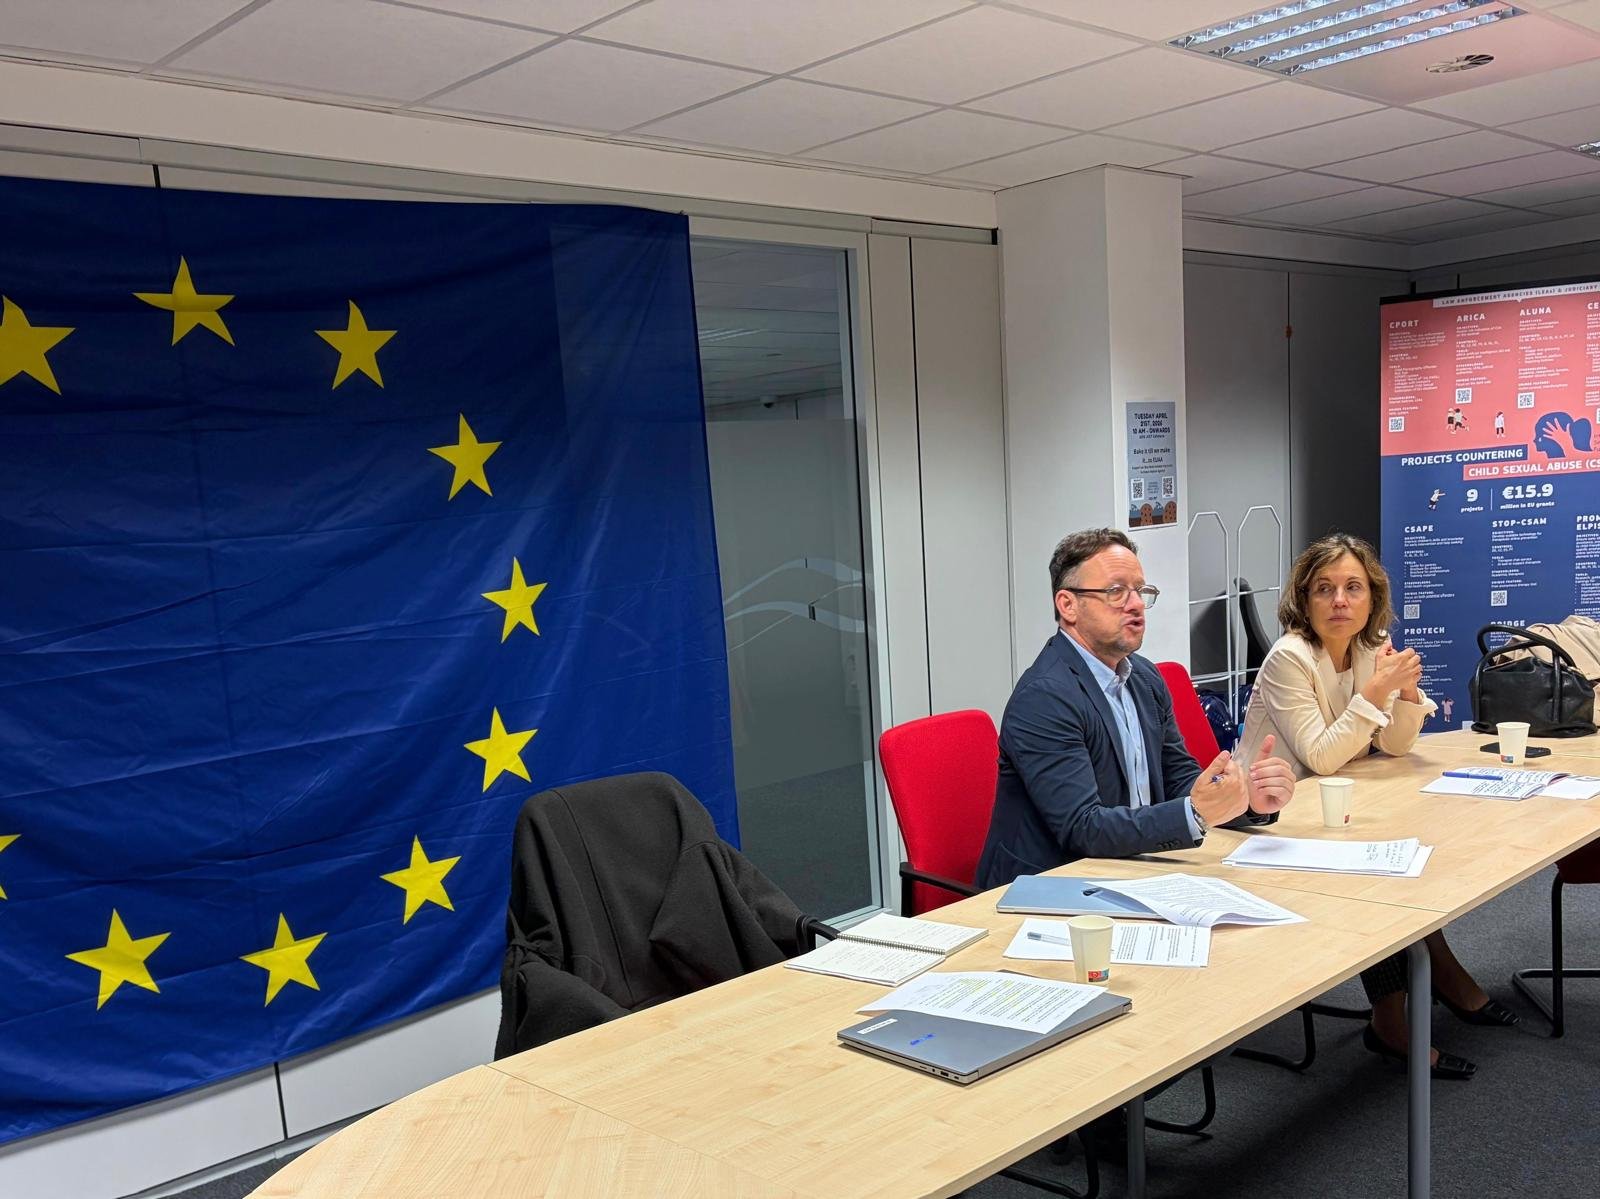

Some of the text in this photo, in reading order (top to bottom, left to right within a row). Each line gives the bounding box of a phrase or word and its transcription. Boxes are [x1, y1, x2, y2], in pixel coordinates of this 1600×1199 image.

[1458, 294, 1500, 304] ENFORCEMENT
[1502, 290, 1532, 298] AGENCIES
[1565, 284, 1598, 293] JUDICIARY
[1520, 306, 1552, 316] ALUNA
[1456, 314, 1486, 322] ARICA
[1389, 320, 1419, 329] CPORT
[1402, 449, 1523, 466] PROJECTS COUNTERING
[1468, 466, 1500, 477] CHILD
[1503, 463, 1543, 474] SEXUAL
[1547, 460, 1582, 471] ABUSE
[1466, 488, 1478, 502] 9
[1502, 484, 1554, 500] €15.9
[1492, 518, 1546, 528] STOP-CSAM
[1404, 627, 1445, 635] PROTECH
